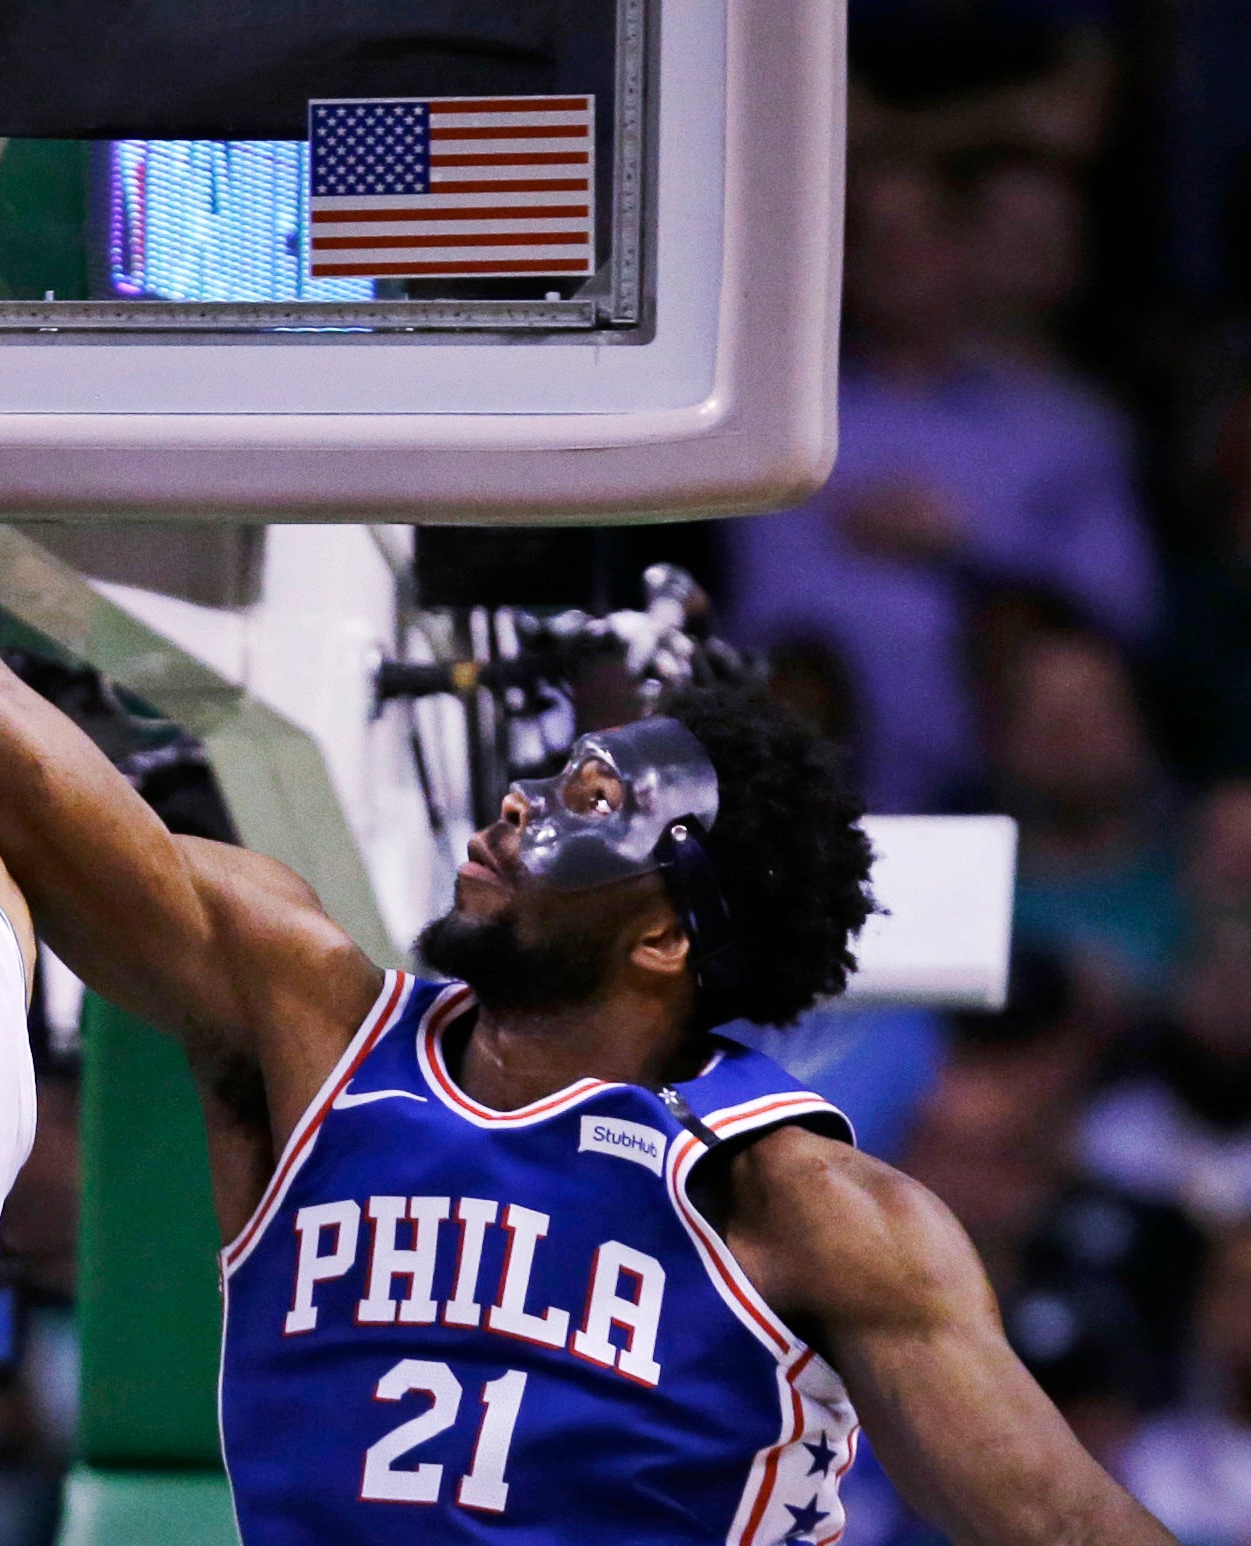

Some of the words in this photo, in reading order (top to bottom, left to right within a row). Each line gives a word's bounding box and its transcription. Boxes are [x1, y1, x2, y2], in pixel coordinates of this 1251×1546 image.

[593, 1125, 657, 1158] StubHub
[284, 1195, 667, 1387] PHILA
[360, 1358, 528, 1512] 21
